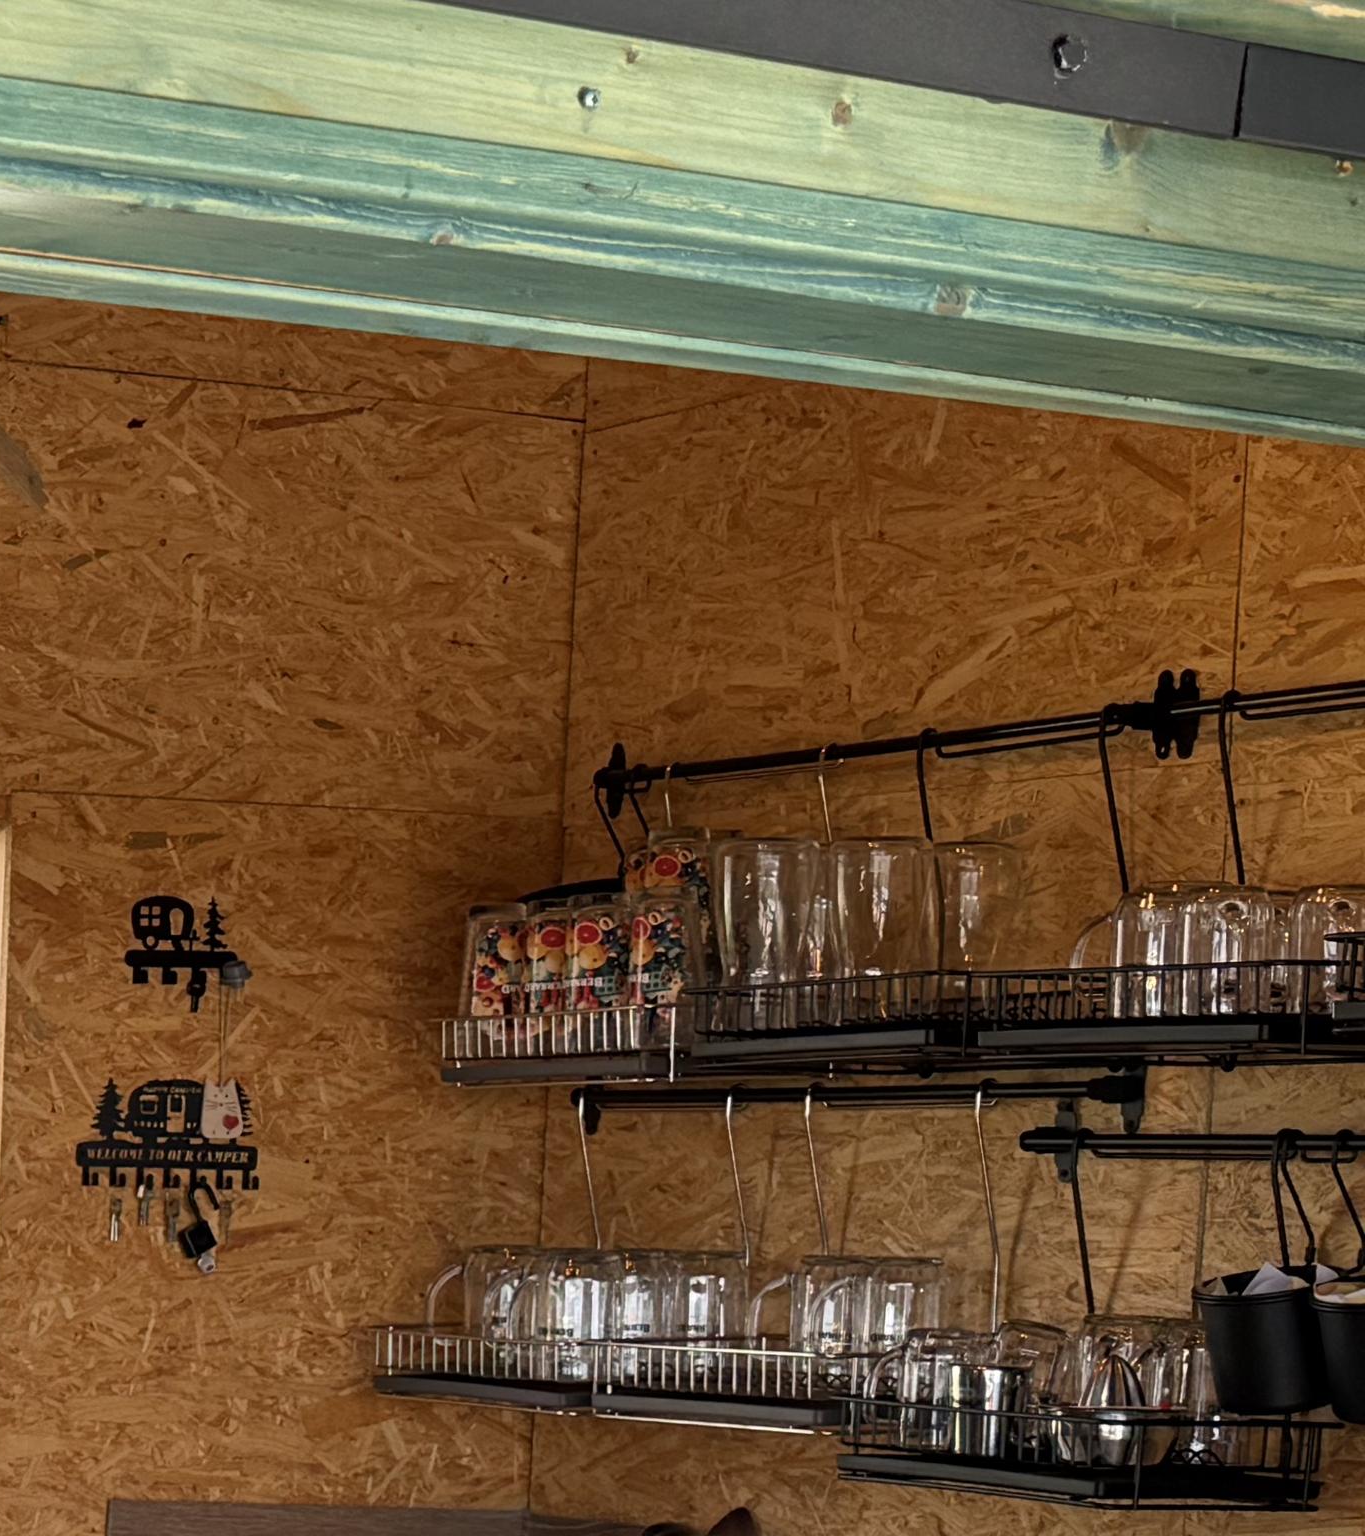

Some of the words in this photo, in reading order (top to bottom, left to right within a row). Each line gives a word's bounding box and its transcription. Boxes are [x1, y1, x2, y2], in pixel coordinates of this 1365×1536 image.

[86, 1148, 145, 1161] WELCOME
[149, 1149, 165, 1161] TO
[167, 1150, 195, 1162] OUR
[197, 1150, 250, 1164] CAMPER
